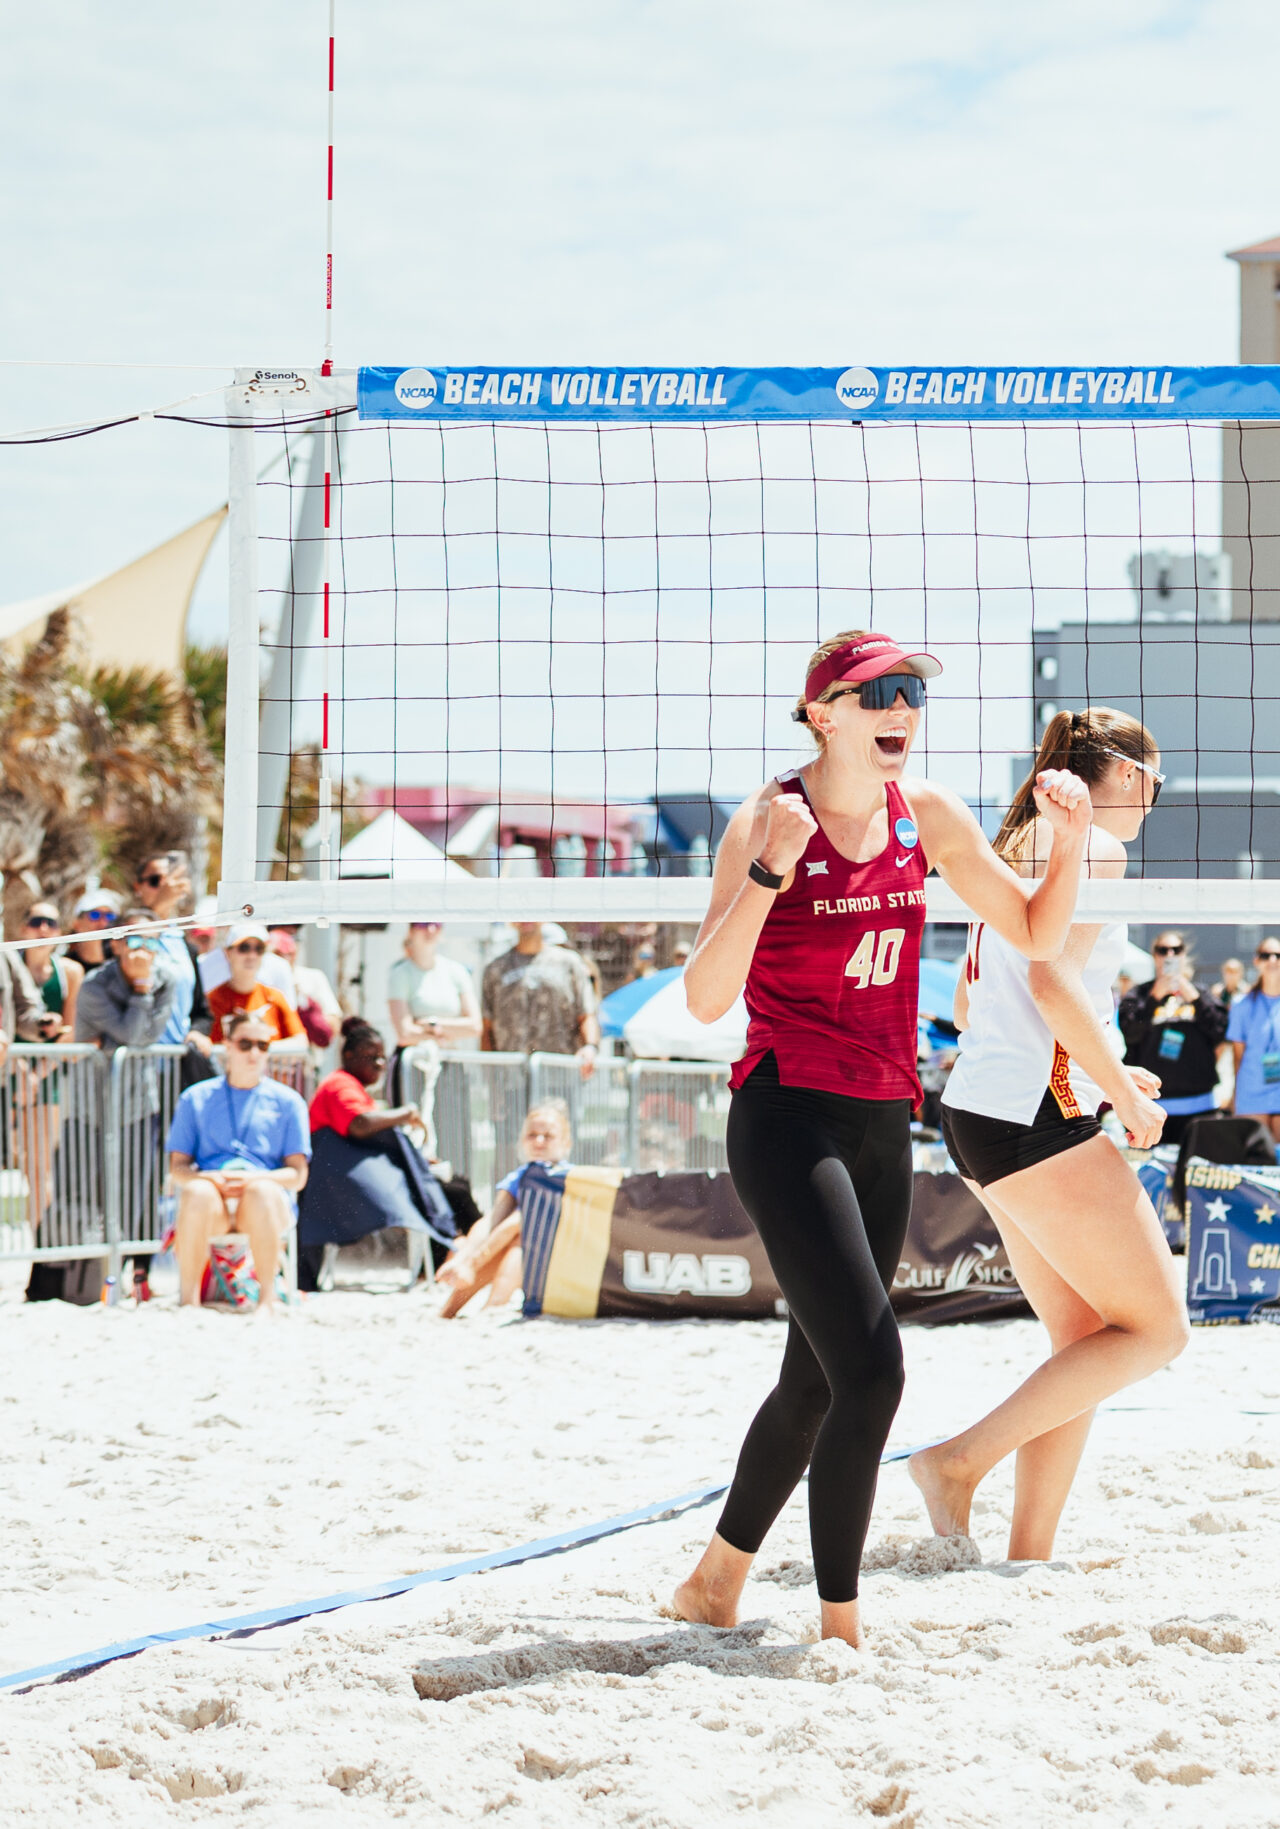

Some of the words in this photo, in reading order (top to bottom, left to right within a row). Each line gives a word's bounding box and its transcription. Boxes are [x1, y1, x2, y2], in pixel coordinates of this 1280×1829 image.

[264, 371, 298, 380] Senoh
[884, 371, 987, 404] BEACH
[995, 371, 1176, 404] VOLLEYBALL
[400, 387, 435, 399] NCAA
[443, 373, 543, 405] BEACH
[551, 373, 728, 406] VOLLEYBALL
[841, 387, 877, 398] NCAA
[813, 895, 881, 915] FLORIDA
[844, 928, 906, 989] 40
[623, 1250, 752, 1297] UAB
